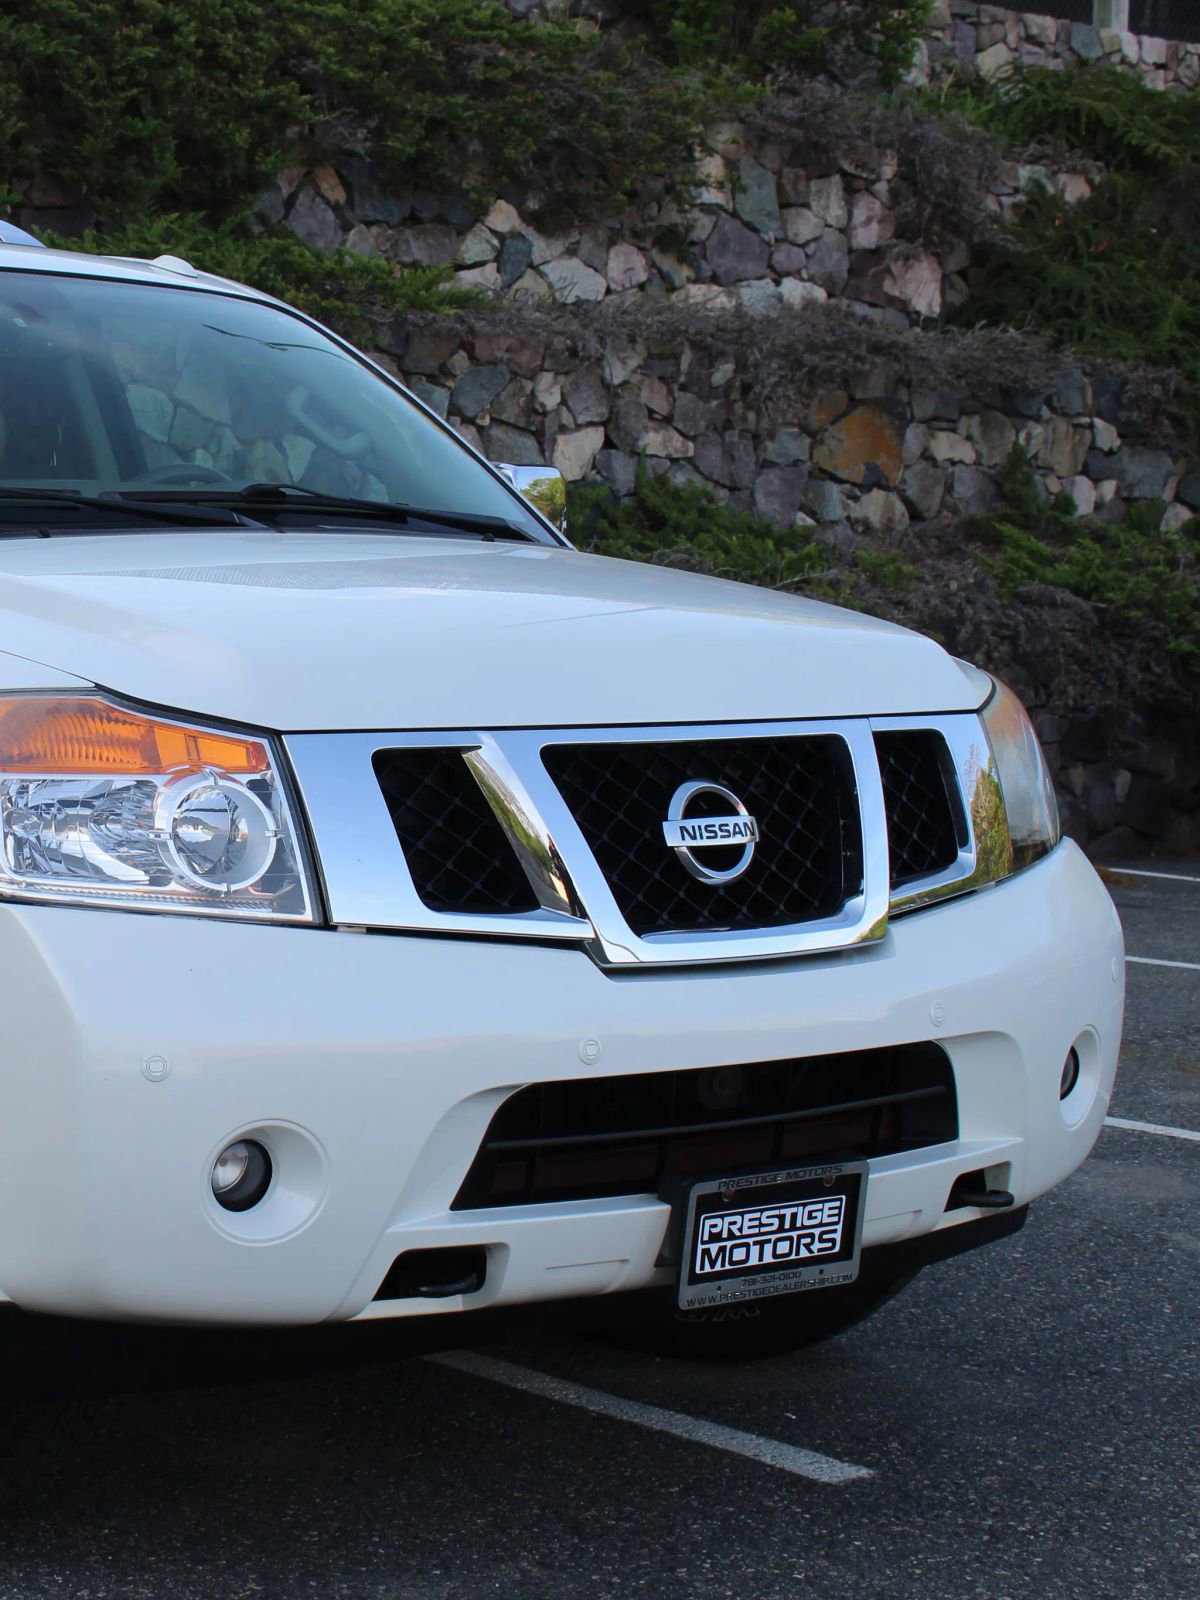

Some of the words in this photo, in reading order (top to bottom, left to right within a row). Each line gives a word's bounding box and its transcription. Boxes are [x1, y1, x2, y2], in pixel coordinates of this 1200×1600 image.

[679, 821, 755, 841] NISSAN
[718, 1173, 783, 1190] PRESTIGE
[785, 1165, 843, 1181] MOTORS
[703, 1201, 841, 1241] PRESTIGE
[699, 1229, 838, 1271] MOTORS
[686, 1273, 853, 1307] WWW.PRESTIGEDEALERSHIP.COM
[741, 1271, 802, 1287] 781-321-0100
